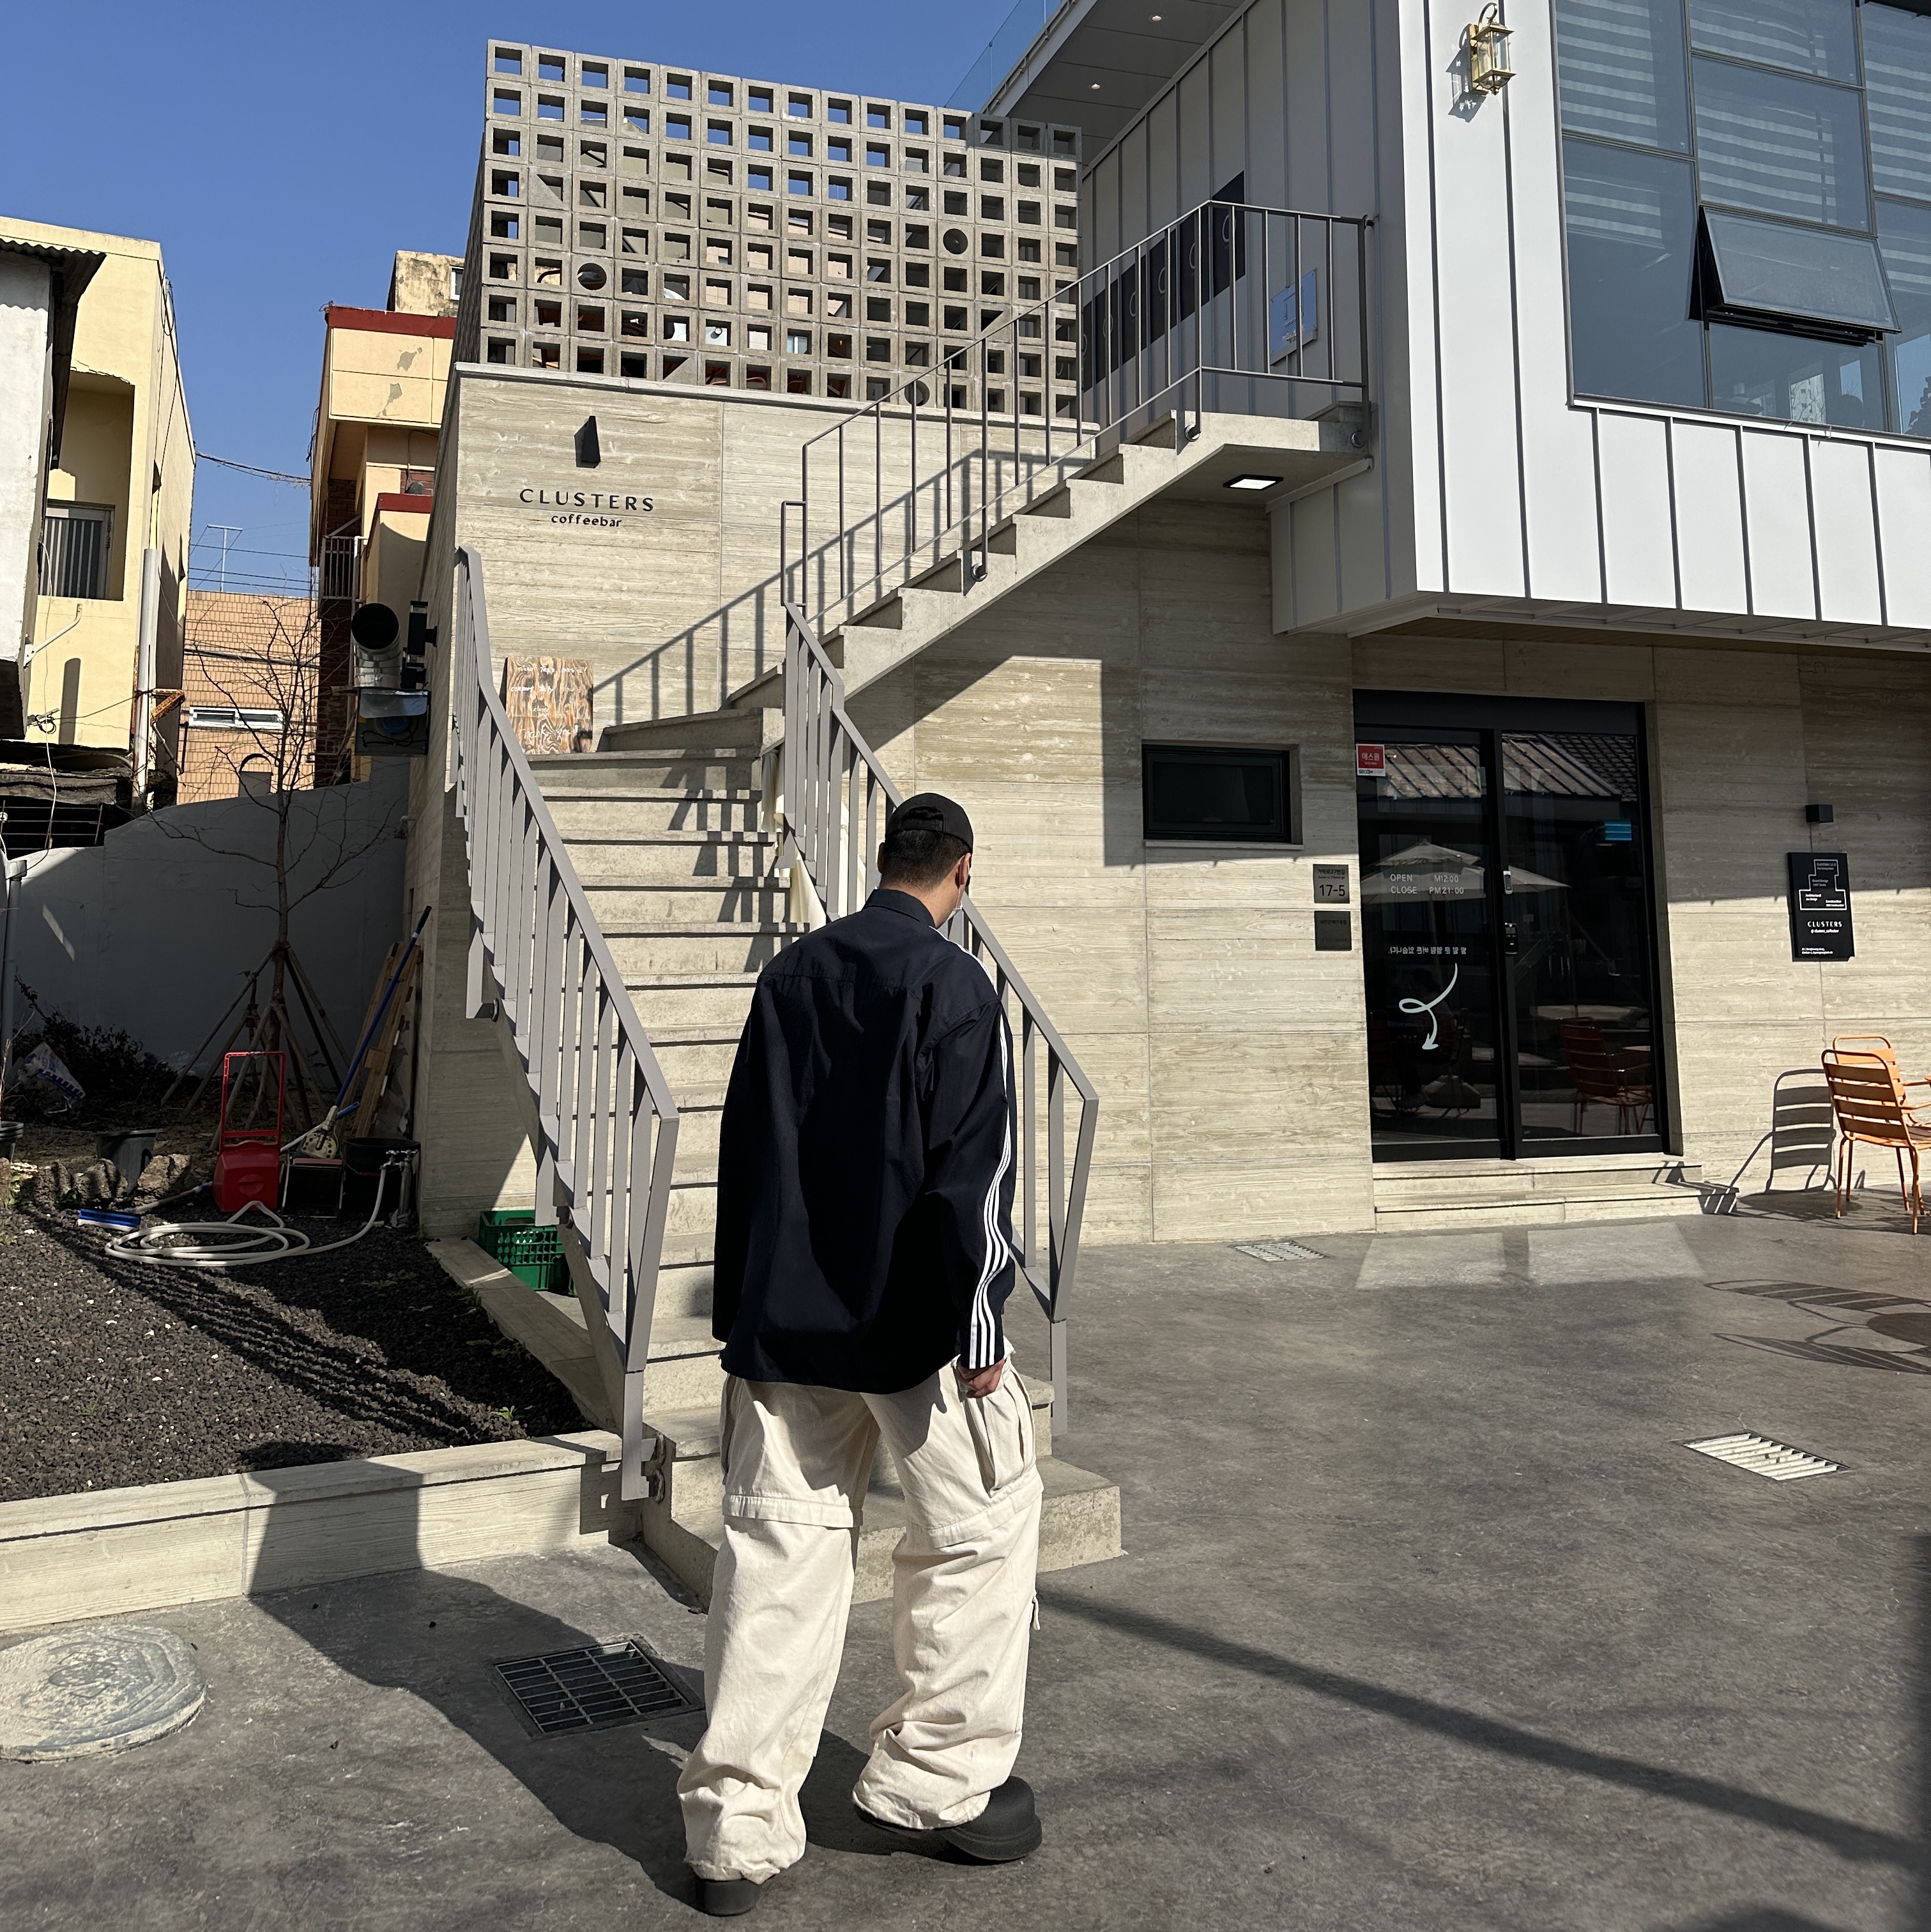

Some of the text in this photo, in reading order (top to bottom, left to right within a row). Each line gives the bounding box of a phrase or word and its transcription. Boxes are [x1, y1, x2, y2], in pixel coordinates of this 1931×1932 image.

[519, 489, 654, 512] CLUSTERS
[551, 514, 622, 527] coffeebar
[1361, 752, 1380, 761] 에스원
[1319, 884, 1345, 896] 17-5
[1391, 885, 1418, 894] CLOSE
